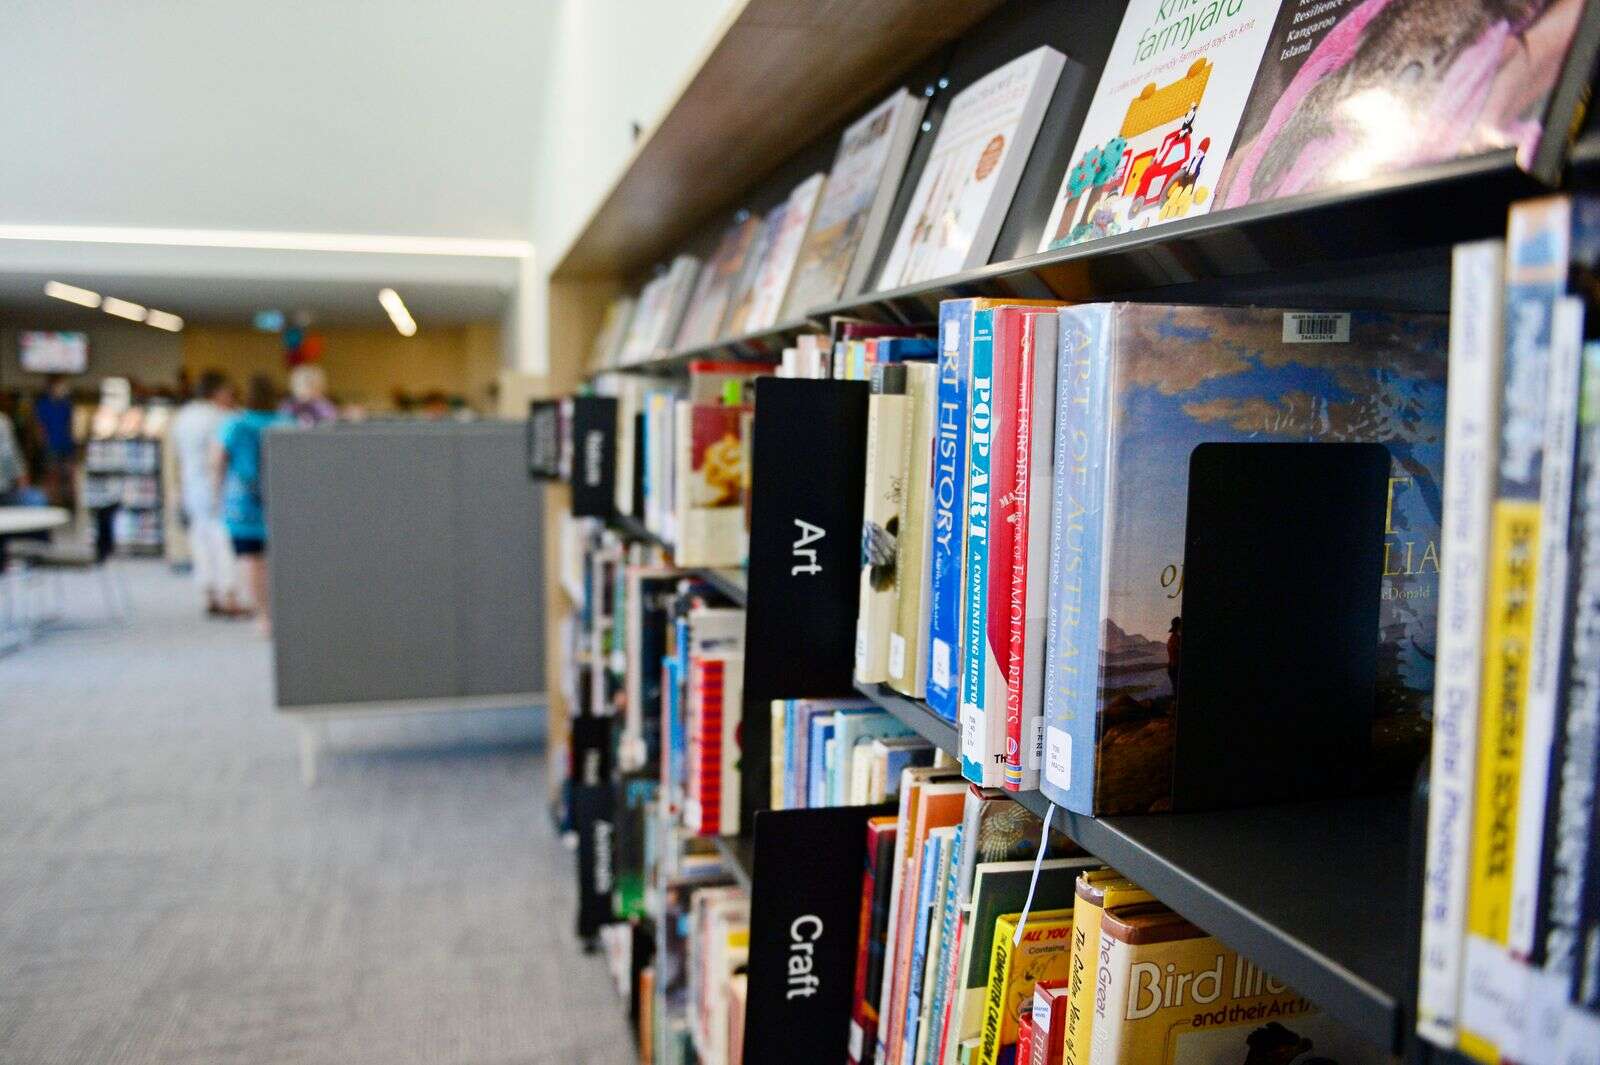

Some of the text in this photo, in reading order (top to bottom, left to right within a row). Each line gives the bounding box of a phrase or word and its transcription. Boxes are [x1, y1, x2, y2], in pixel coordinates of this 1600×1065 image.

[1280, 39, 1312, 61] Island
[1286, 15, 1336, 43] Kangaroo
[1070, 328, 1093, 414] ART
[935, 348, 960, 555] RT HISTORY
[969, 376, 991, 545] POP ART
[791, 518, 826, 576] Art
[970, 564, 982, 656] CONTINUING
[1009, 562, 1025, 644] FAMOUS
[1054, 494, 1087, 722] AUSTRALIA
[967, 658, 980, 705] HISTO
[1007, 650, 1022, 724] ARTISTS
[786, 914, 824, 1000] Craft
[1023, 927, 1070, 942] ALL YOU
[1075, 926, 1086, 952] The
[991, 945, 1007, 1009] COMPUTER
[1096, 966, 1112, 1019] Great
[1125, 954, 1223, 1021] Bird
[1191, 1004, 1228, 1028] and
[1229, 1001, 1267, 1022] their
[1266, 999, 1296, 1017] Art
